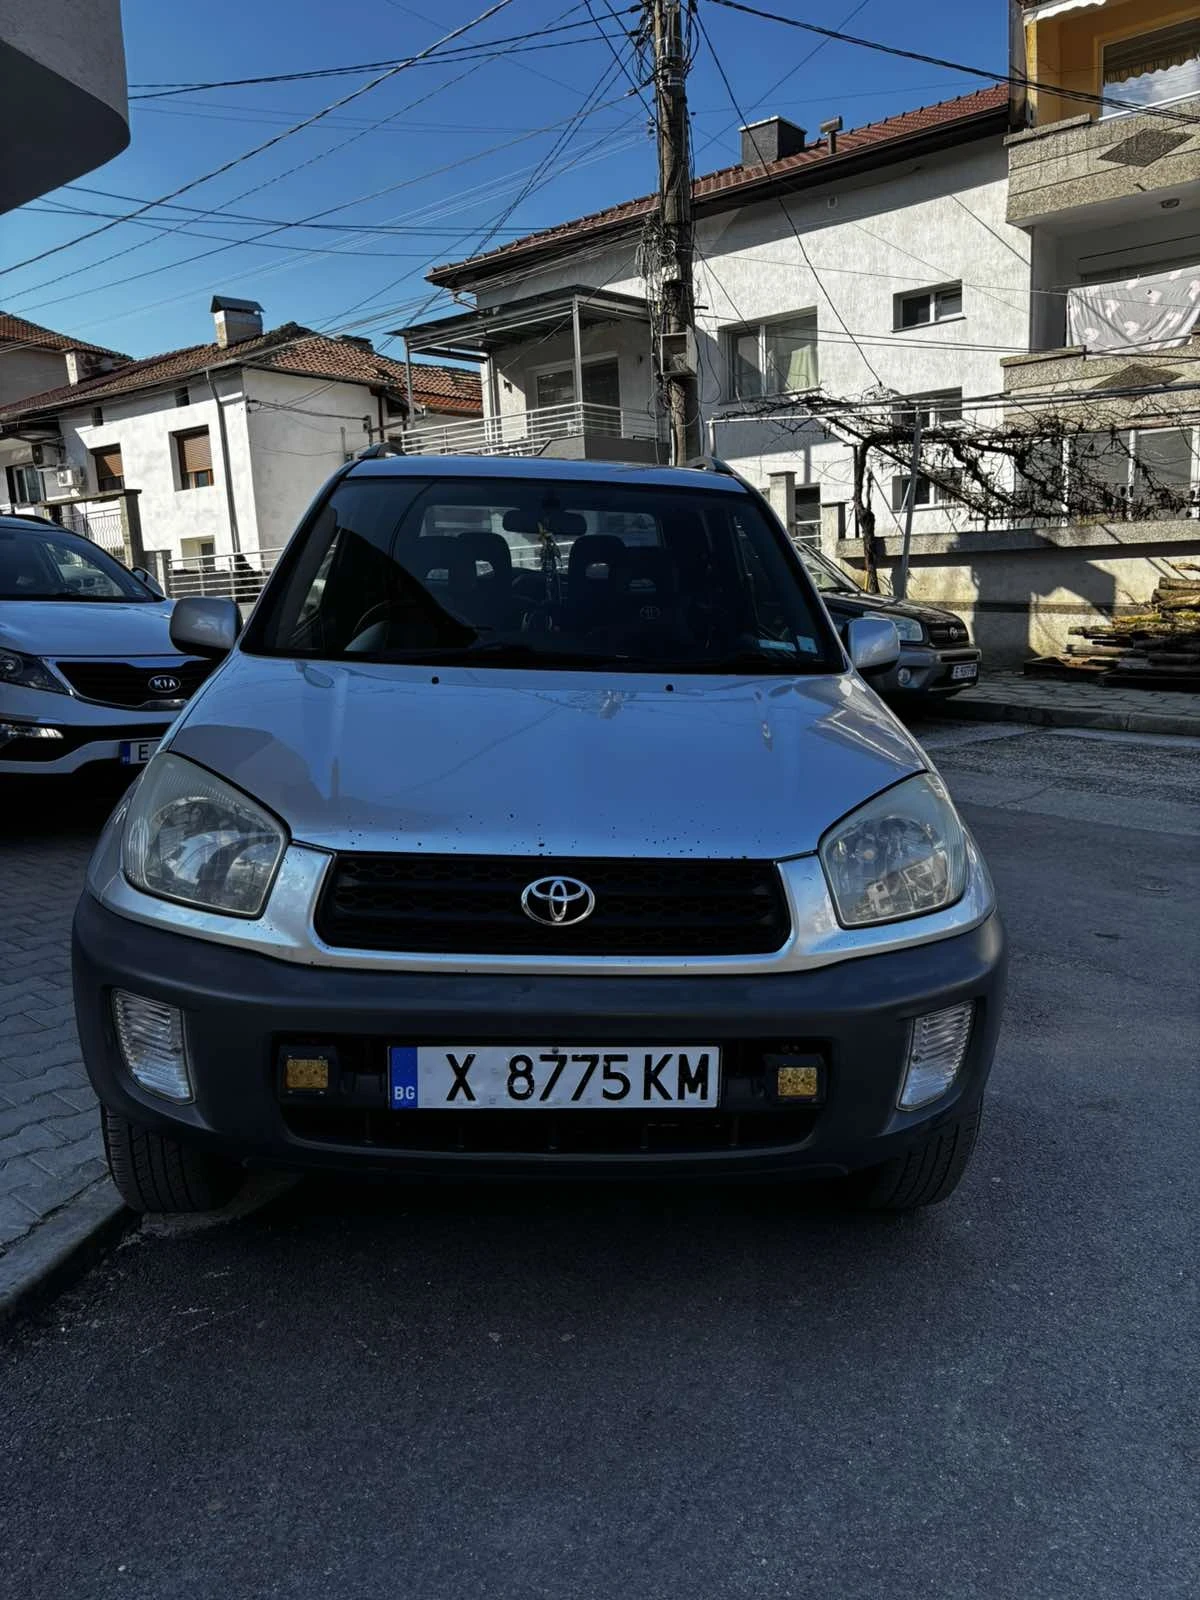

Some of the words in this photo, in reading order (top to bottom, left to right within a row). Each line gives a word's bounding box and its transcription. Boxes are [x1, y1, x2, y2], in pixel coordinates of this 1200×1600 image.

[153, 678, 176, 689] KIA
[138, 744, 149, 761] E
[446, 1054, 476, 1101] X
[507, 1054, 631, 1101] 8775
[643, 1054, 709, 1101] KM
[394, 1086, 415, 1100] BG
